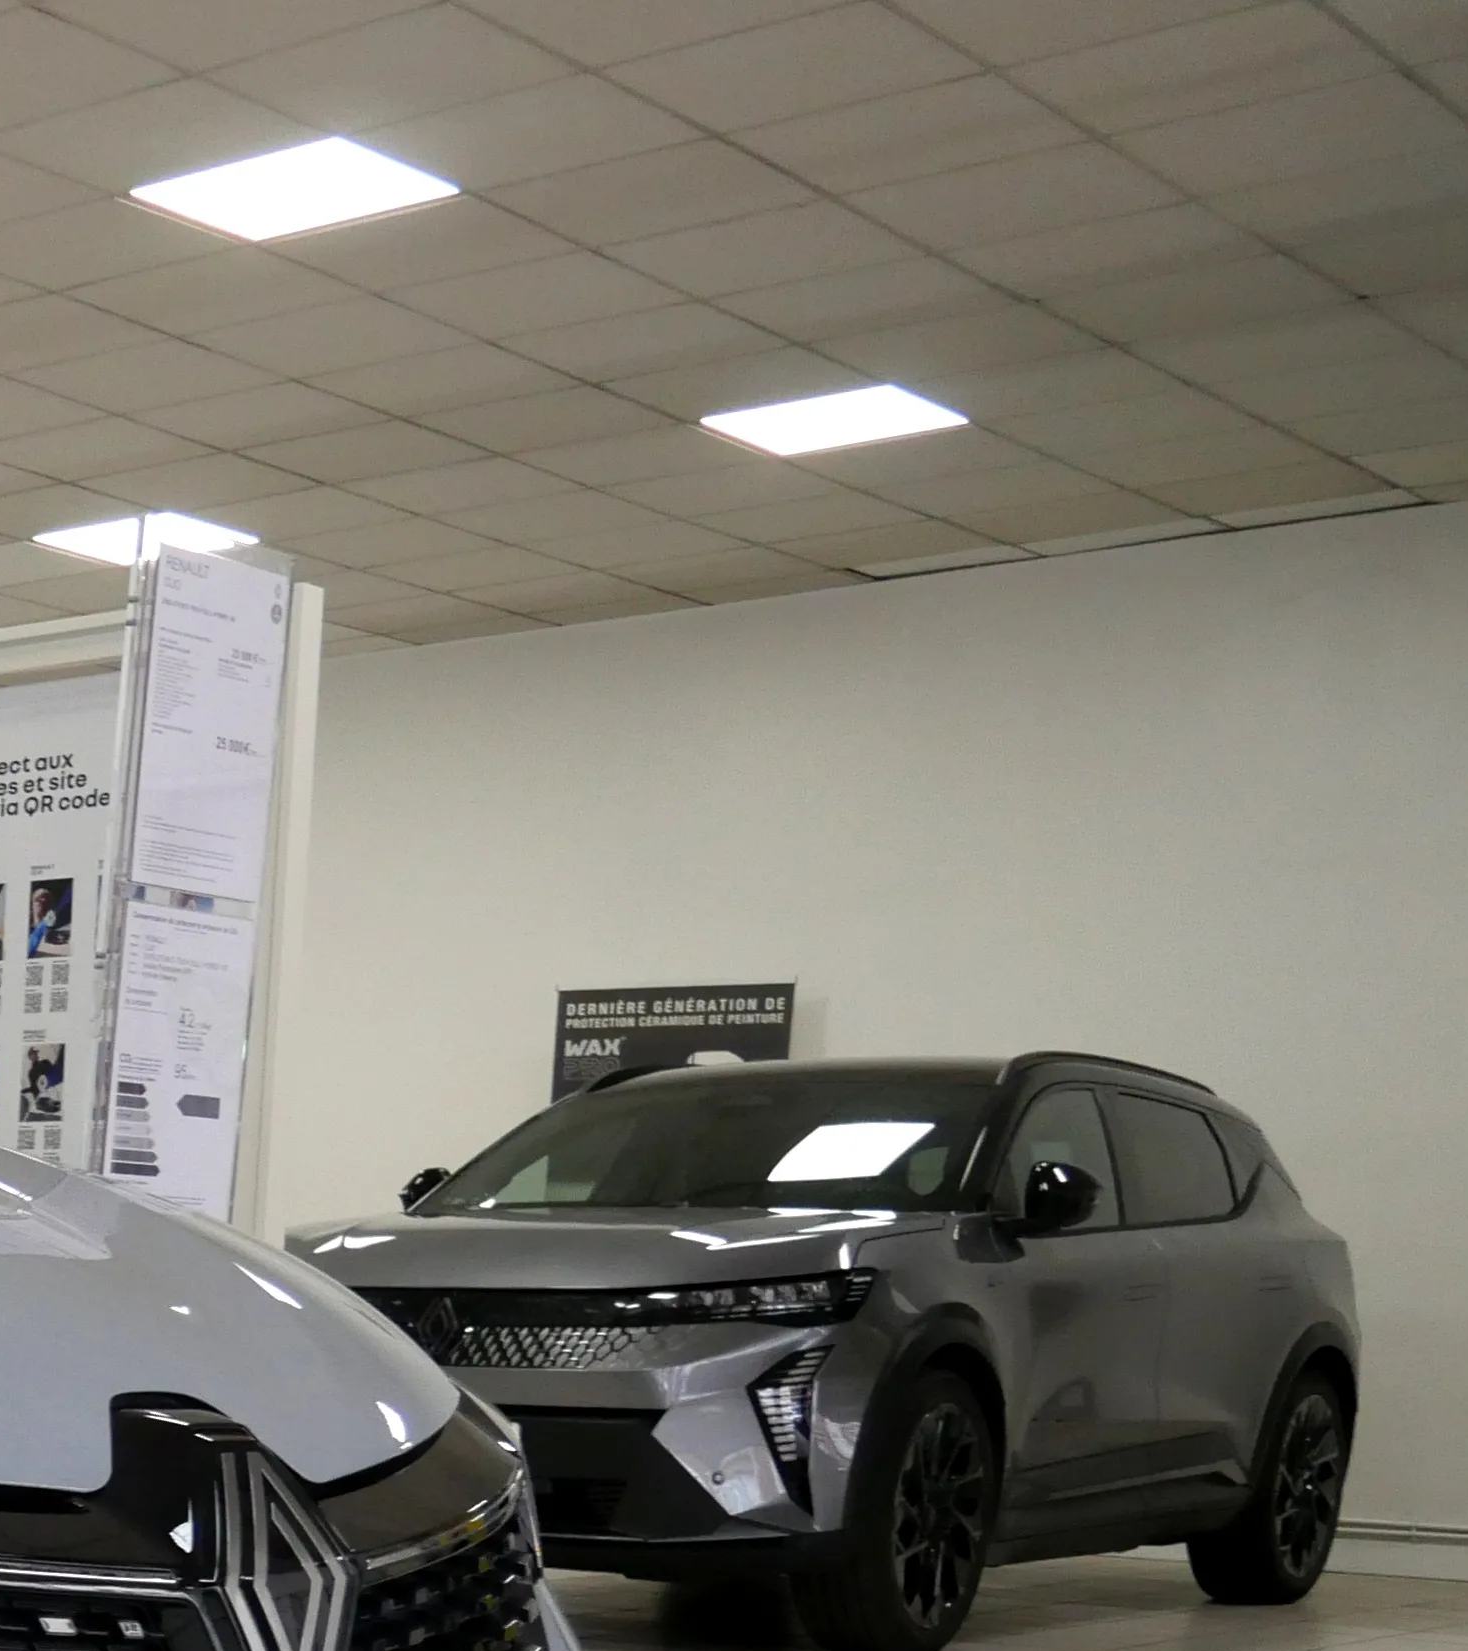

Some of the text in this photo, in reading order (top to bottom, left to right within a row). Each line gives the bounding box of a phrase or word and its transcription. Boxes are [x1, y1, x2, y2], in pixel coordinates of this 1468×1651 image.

[34, 753, 74, 771] aux
[23, 776, 44, 793] et
[49, 771, 87, 791] site
[24, 795, 54, 816] QR
[58, 788, 111, 811] code
[566, 997, 786, 1017] DERNIÈRE GÉNÉRATION DE
[565, 1013, 784, 1029] PROTECTION CÉRAMIQUE DE PEINTURE
[564, 1038, 621, 1057] WAX
